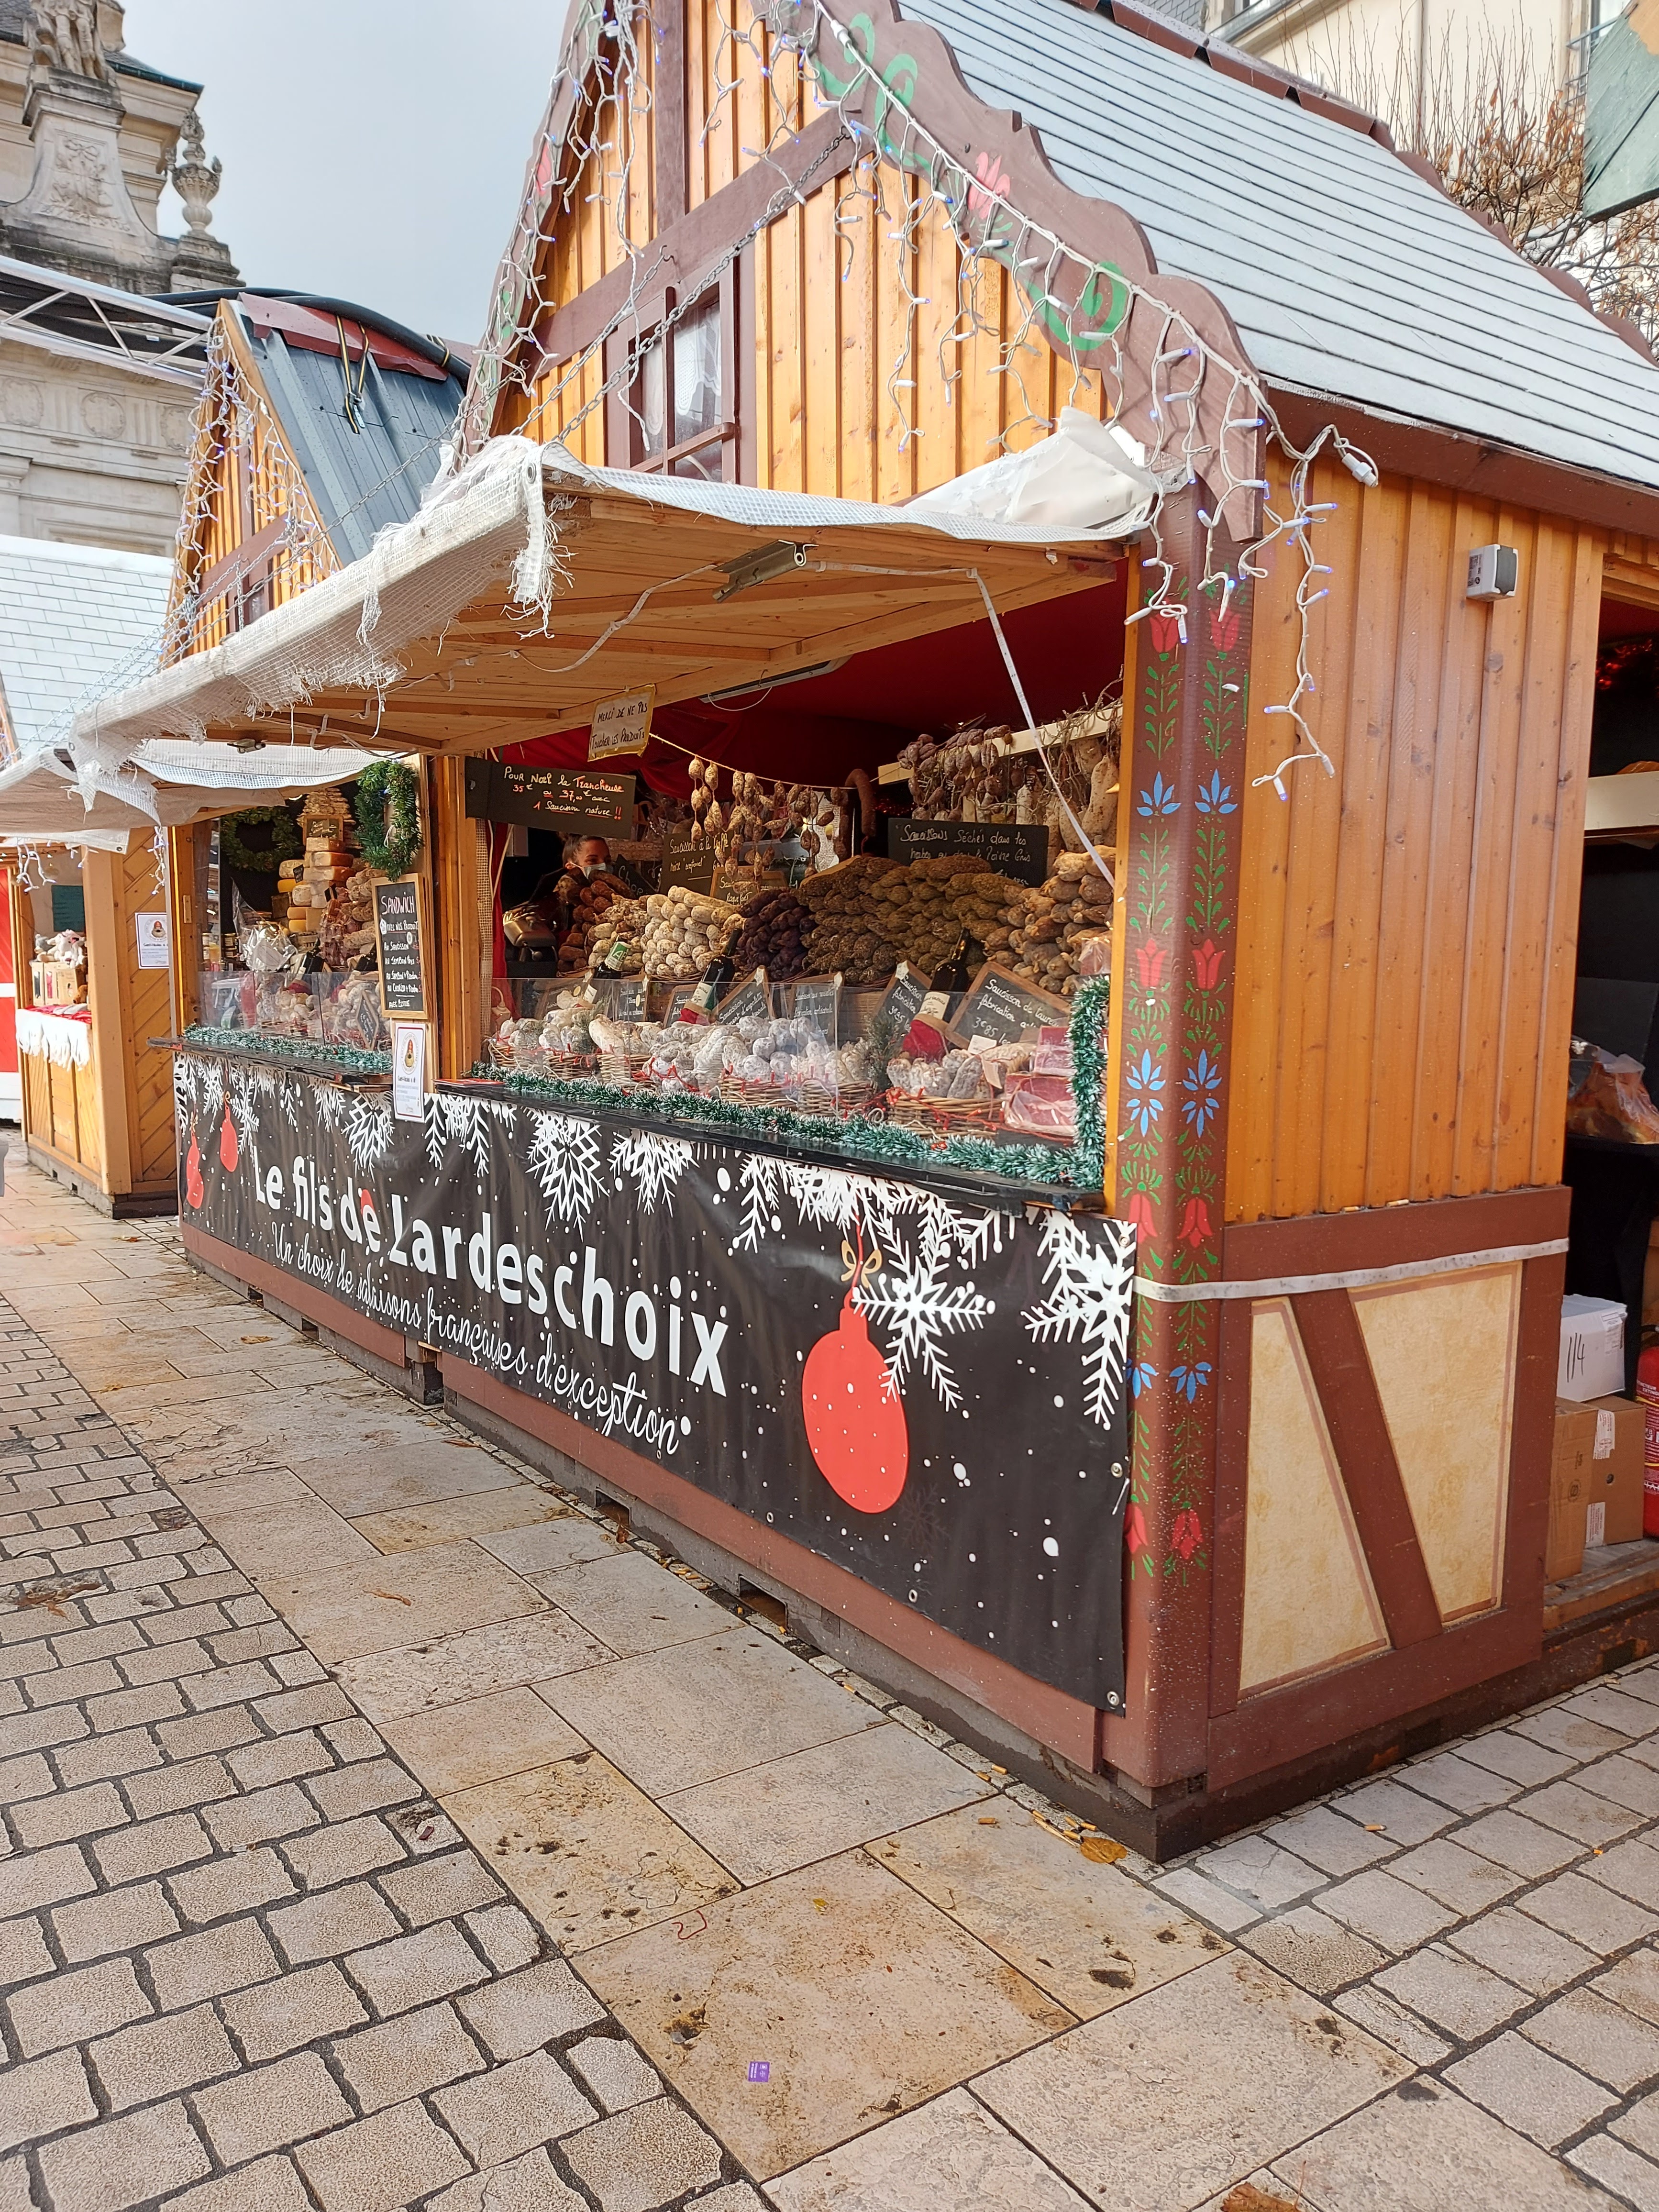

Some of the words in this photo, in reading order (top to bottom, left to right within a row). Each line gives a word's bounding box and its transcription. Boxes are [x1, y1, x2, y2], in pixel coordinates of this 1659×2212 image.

[616, 707, 625, 718] DE
[627, 705, 636, 717] NE
[638, 701, 648, 714] PAS
[558, 774, 571, 787] la
[573, 775, 624, 793] Trancheuse
[545, 801, 580, 812] Saucisson
[585, 805, 613, 817] nature
[381, 891, 415, 915] SANDWICH
[976, 994, 1016, 1022] fabrication
[984, 979, 1022, 1008] Saucisson
[1023, 1001, 1033, 1014] de
[253, 1145, 283, 1211] Le
[292, 1155, 333, 1231] fils
[340, 1176, 381, 1253] de
[388, 1194, 729, 1398] Lardeschoix
[271, 1221, 294, 1266] Un
[297, 1232, 334, 1284] choix
[335, 1248, 354, 1293] de
[356, 1262, 422, 1329] salaisons
[426, 1286, 527, 1376] françaises
[535, 1333, 680, 1455] d'exception
